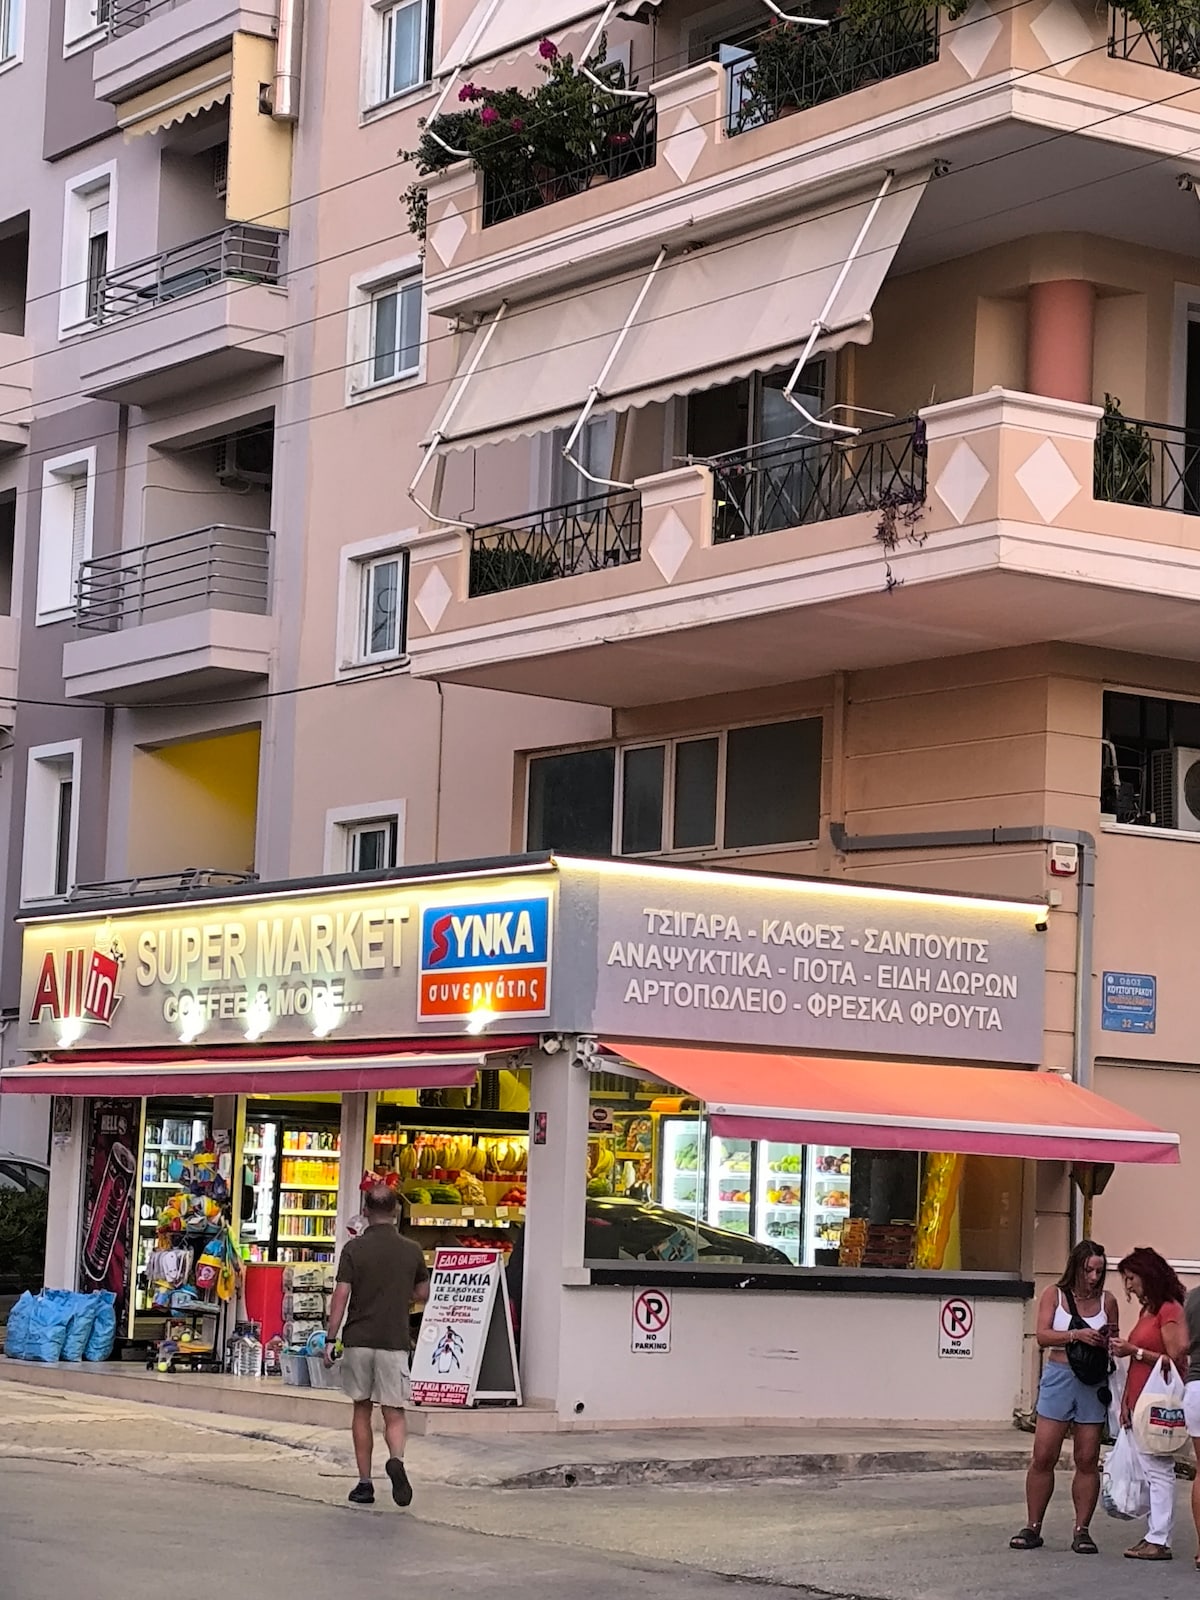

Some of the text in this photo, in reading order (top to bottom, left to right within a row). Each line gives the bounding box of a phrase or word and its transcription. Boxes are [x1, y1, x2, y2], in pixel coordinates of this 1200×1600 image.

[136, 906, 410, 987] SUPER MARKET
[428, 910, 535, 966] SYNKA
[643, 907, 742, 942] ΤΣΙΓΑΡΑ
[762, 919, 845, 950] ΚΑΦΕΣ
[864, 928, 990, 963] ΣΑΝΤΟΥΙΤΣ
[29, 947, 113, 1024] All in
[606, 940, 772, 979] ΑΝΑΨΥΚΤΙΚΑ
[793, 956, 857, 986] ΠΟΤΑ
[877, 964, 931, 992] ΕΙΔΗ
[935, 969, 1018, 999] ΔΩΡΩΝ
[1119, 977, 1141, 986] ΟΔΟΣ
[163, 990, 248, 1023] COFFEE
[428, 975, 538, 1007] συνεργάτης
[623, 978, 787, 1015] ΑΡΤΟΠΩΛΕΙΟ
[807, 992, 904, 1024] ΦΡΕΣΚΑ
[910, 1000, 1003, 1031] ΦΡΟΥΤΑ
[433, 1272, 491, 1286] ΠΑΓΑΚΙΑ
[433, 1294, 484, 1303] ICE CUBES
[635, 1342, 667, 1350] PARKING
[645, 1333, 657, 1341] NO
[941, 1347, 971, 1356] PARKING
